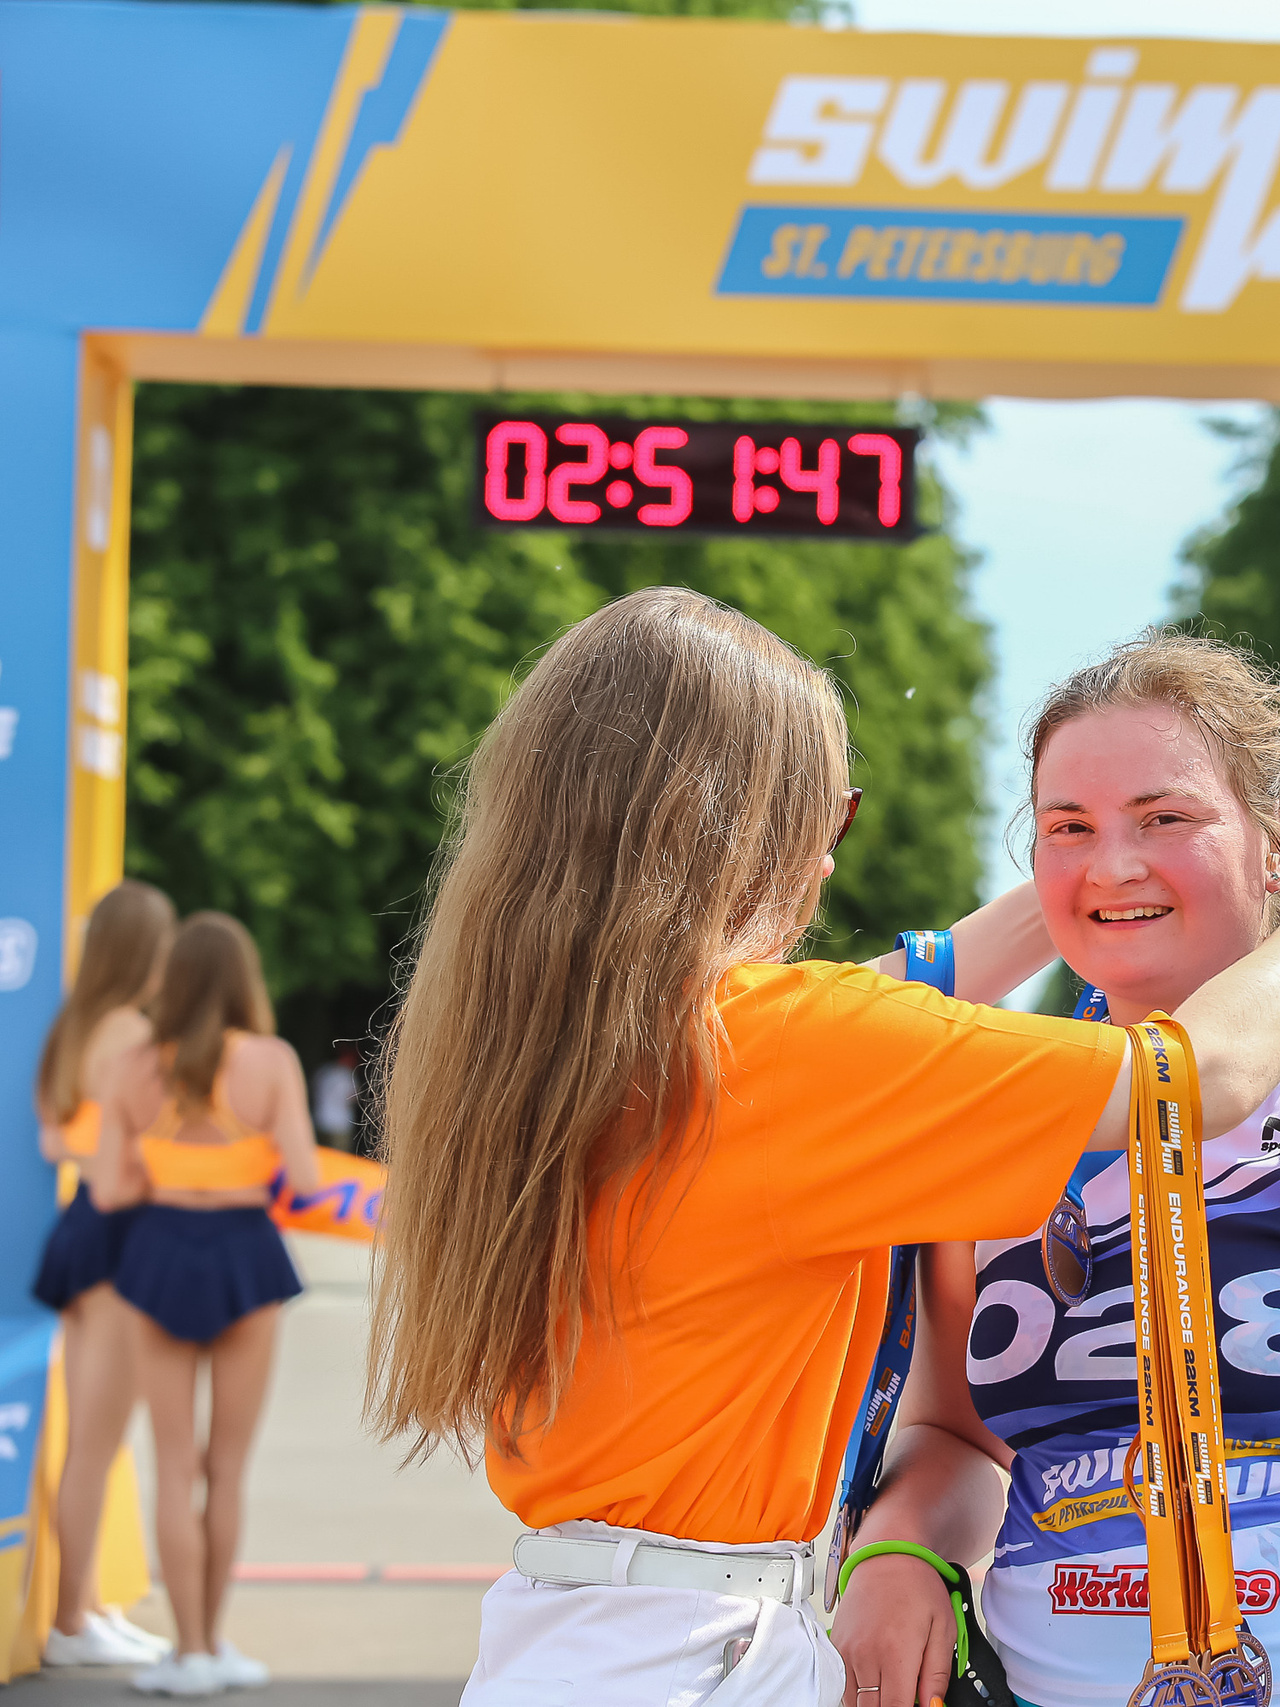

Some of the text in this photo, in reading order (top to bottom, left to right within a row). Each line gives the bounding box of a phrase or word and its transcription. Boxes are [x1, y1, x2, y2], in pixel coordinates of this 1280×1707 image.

[763, 225, 1126, 287] ST. PETERSBURG
[1145, 1028, 1171, 1083] 22KM
[1168, 1192, 1194, 1344] ENDURANCE
[1184, 1348, 1200, 1417] 22KM
[1143, 1355, 1154, 1426] 22KM
